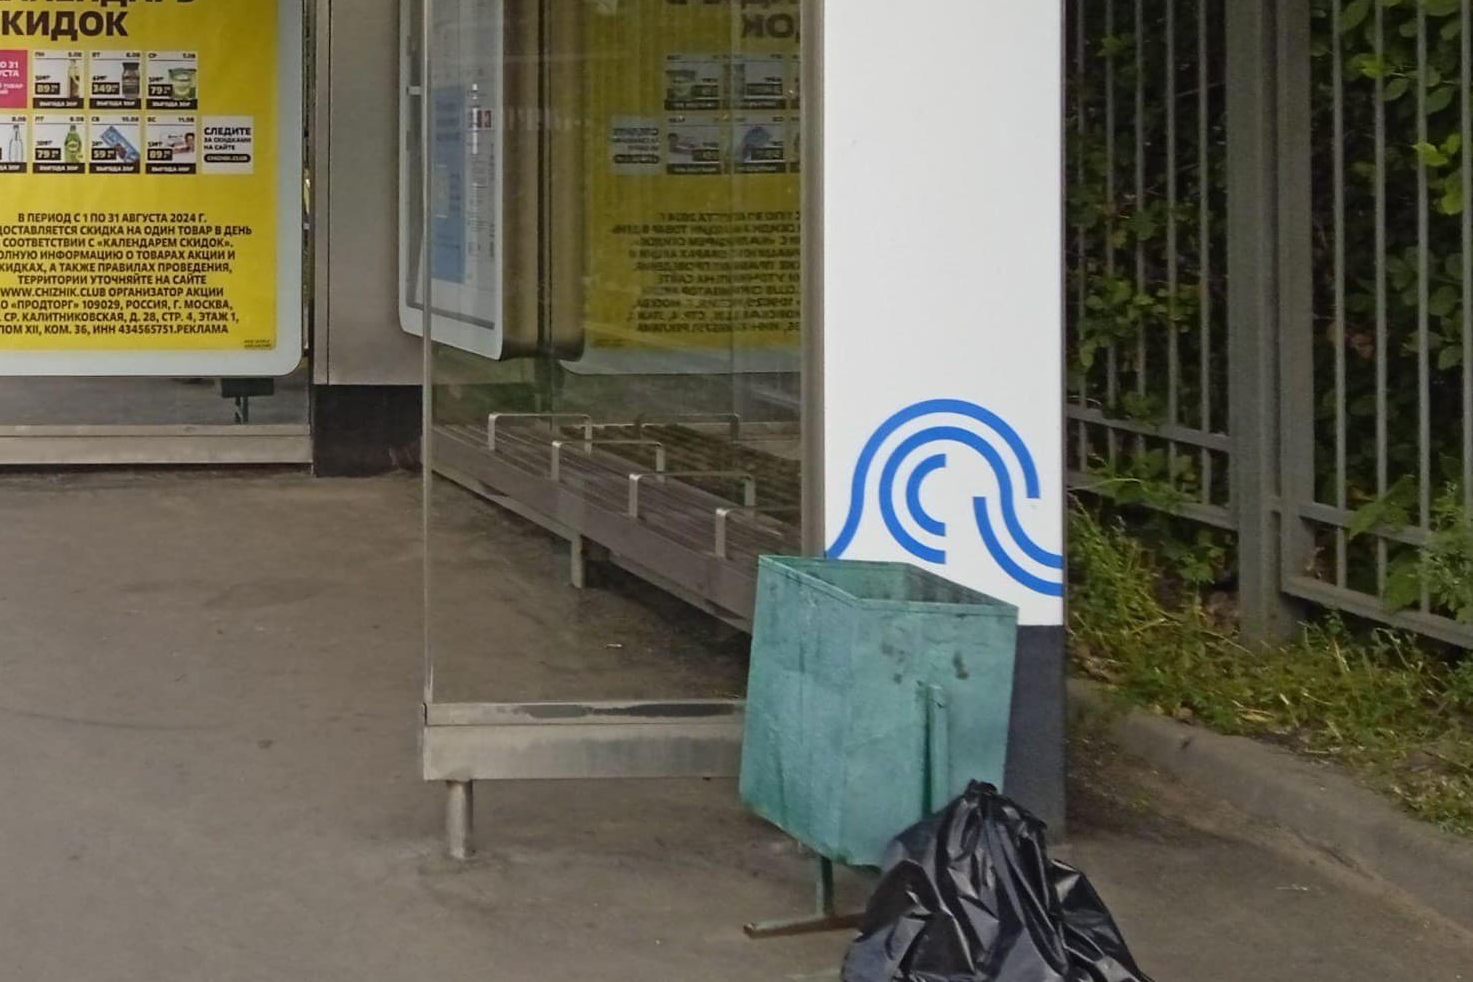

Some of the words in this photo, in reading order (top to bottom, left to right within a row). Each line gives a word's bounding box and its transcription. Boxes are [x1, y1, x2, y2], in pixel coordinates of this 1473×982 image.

[204, 127, 251, 136] СЛЕДИТЕ
[18, 213, 25, 223] В
[28, 213, 71, 223] ПЕРИОД
[74, 213, 81, 223] С
[83, 213, 87, 223] 1
[91, 213, 106, 223] ПО
[108, 213, 119, 223] 31
[122, 213, 167, 223] АВГУСТА
[171, 213, 196, 223] 2024
[199, 213, 207, 223] Г.
[80, 226, 124, 236] СКИДКА
[127, 226, 141, 236] НА
[144, 226, 175, 236] ОДИН
[178, 226, 212, 236] ТОВАР
[215, 226, 221, 236] В
[223, 226, 252, 236] ДЕНЬ
[3, 238, 85, 248] СООТВЕТСТВИИ
[88, 238, 95, 248] С
[97, 238, 177, 248] «КАЛЕНДАРЕМ
[179, 238, 233, 248] СКИДОК».
[40, 250, 123, 261] ИНФОРМАЦИЮ
[126, 250, 133, 261] О
[136, 250, 185, 261] ТОВАРАХ
[187, 250, 225, 261] АКЦИИ
[227, 250, 235, 261] И
[49, 263, 57, 274] А
[59, 263, 95, 274] ТАКЖЕ
[97, 263, 155, 274] ПРАВИЛАХ
[158, 263, 233, 274] ПРОВЕДЕНИЯ,
[18, 275, 87, 285] ТЕРРИТОРИИ
[90, 275, 153, 285] УТОЧНЯЙТЕ
[155, 275, 170, 285] НА
[173, 275, 207, 285] САЙТЕ
[0, 288, 105, 298] WWW.CHIZHIK.CLUB
[108, 288, 183, 298] ОРГАНИЗАТОР
[185, 288, 224, 298] АКЦИИ
[11, 300, 79, 310] «ПРОДТОРГ»
[83, 300, 123, 310] 109029,
[125, 300, 171, 310] РОССИЯ,
[173, 300, 182, 310] Г.
[184, 300, 233, 310] МОСКВА,
[3, 312, 19, 322] СР.
[22, 312, 127, 322] КАЛИТНИКОВСКАЯ,
[129, 312, 141, 322] Д.
[143, 312, 159, 322] 28,
[161, 312, 183, 322] СТР.
[186, 312, 196, 322] 4,
[199, 312, 228, 322] ЭТАЖ
[231, 312, 239, 322] 1,
[25, 324, 43, 336] XII,
[45, 324, 71, 336] КОМ.
[75, 324, 91, 336] 36,
[93, 324, 116, 336] ИНН
[119, 324, 229, 336] 434565751.РЕКЛАМА
